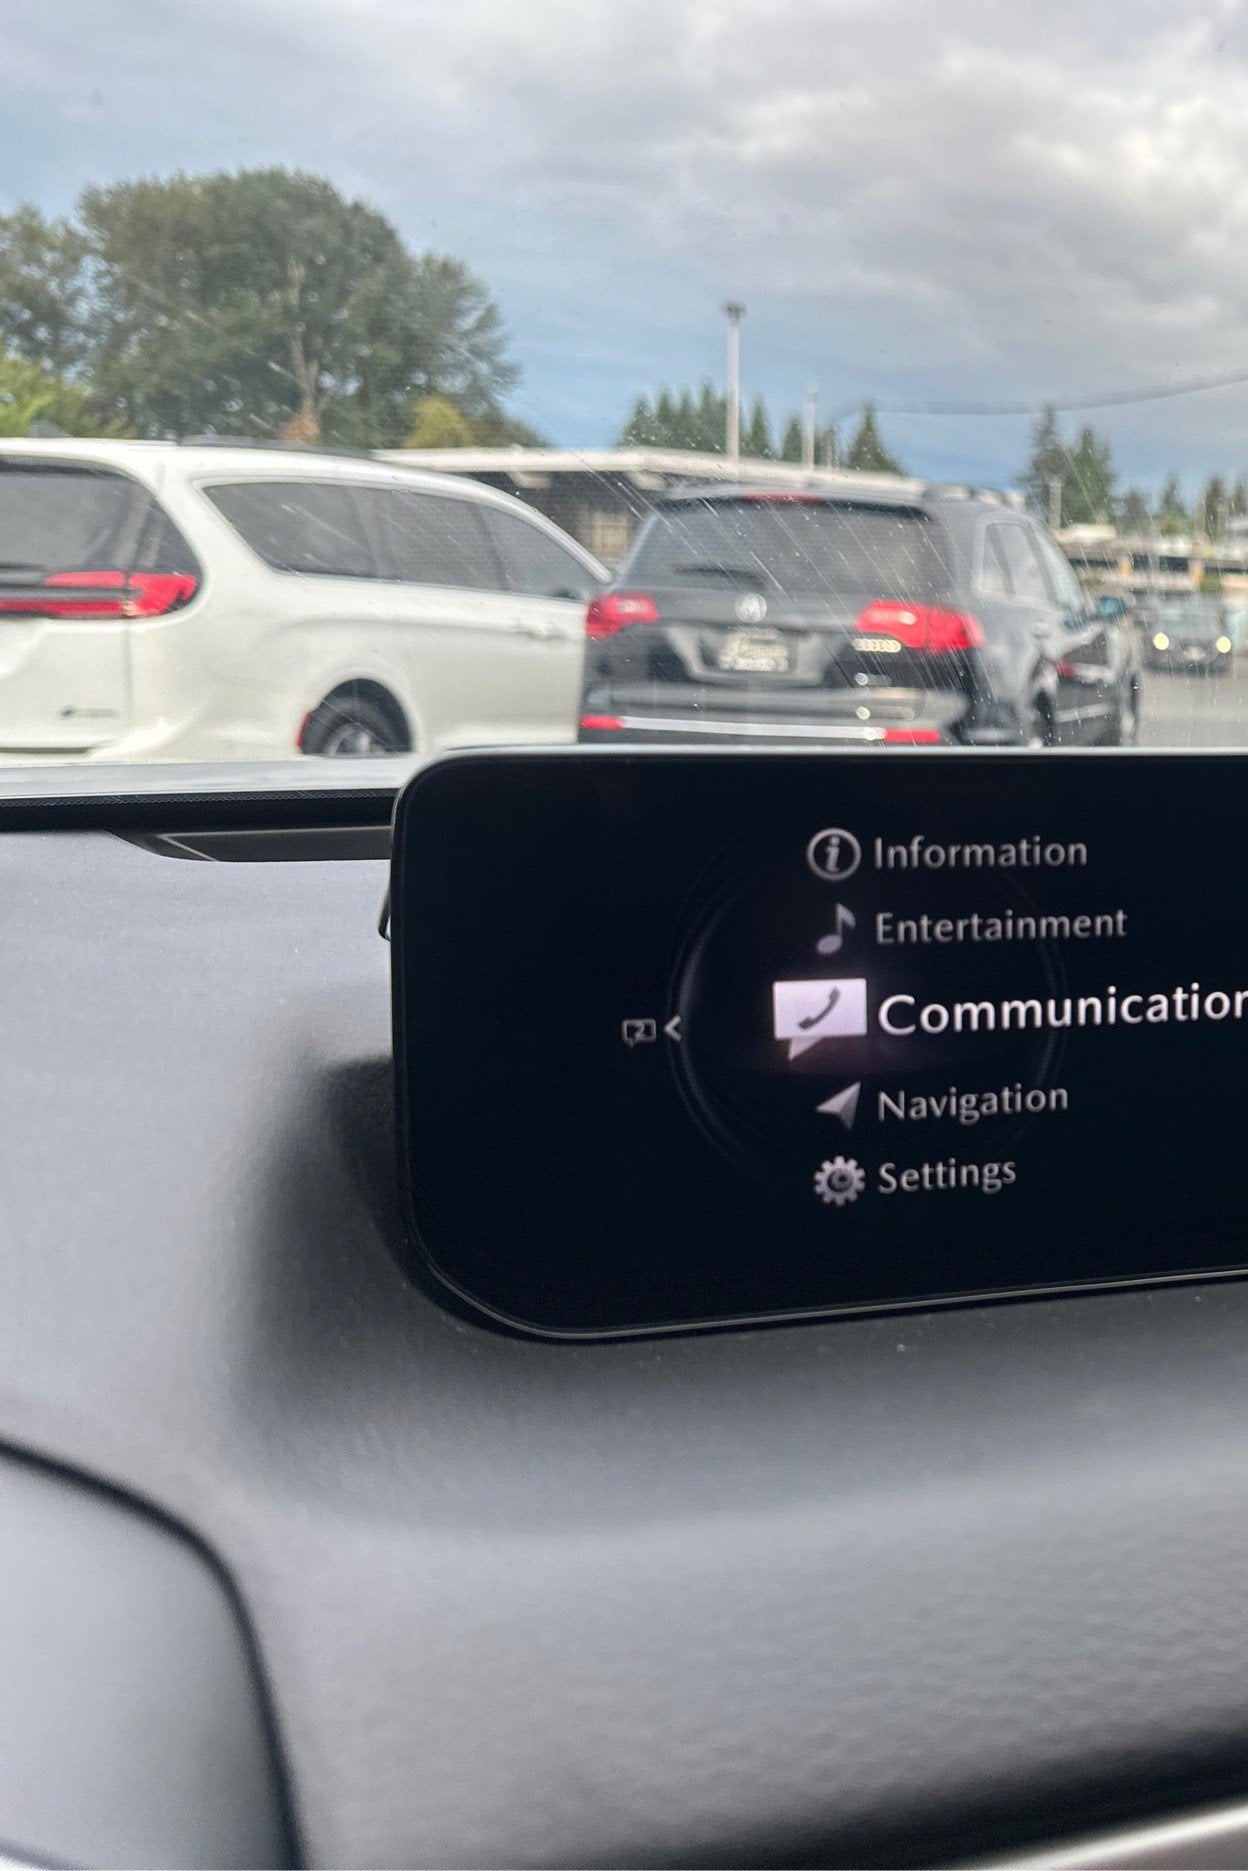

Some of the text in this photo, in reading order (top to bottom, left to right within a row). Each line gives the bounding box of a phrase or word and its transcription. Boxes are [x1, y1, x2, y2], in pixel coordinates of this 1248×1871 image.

[874, 834, 1089, 870] Information
[875, 909, 1129, 945] Entertainment
[878, 1082, 1069, 1126] Navigation
[878, 1157, 1018, 1195] Settings
